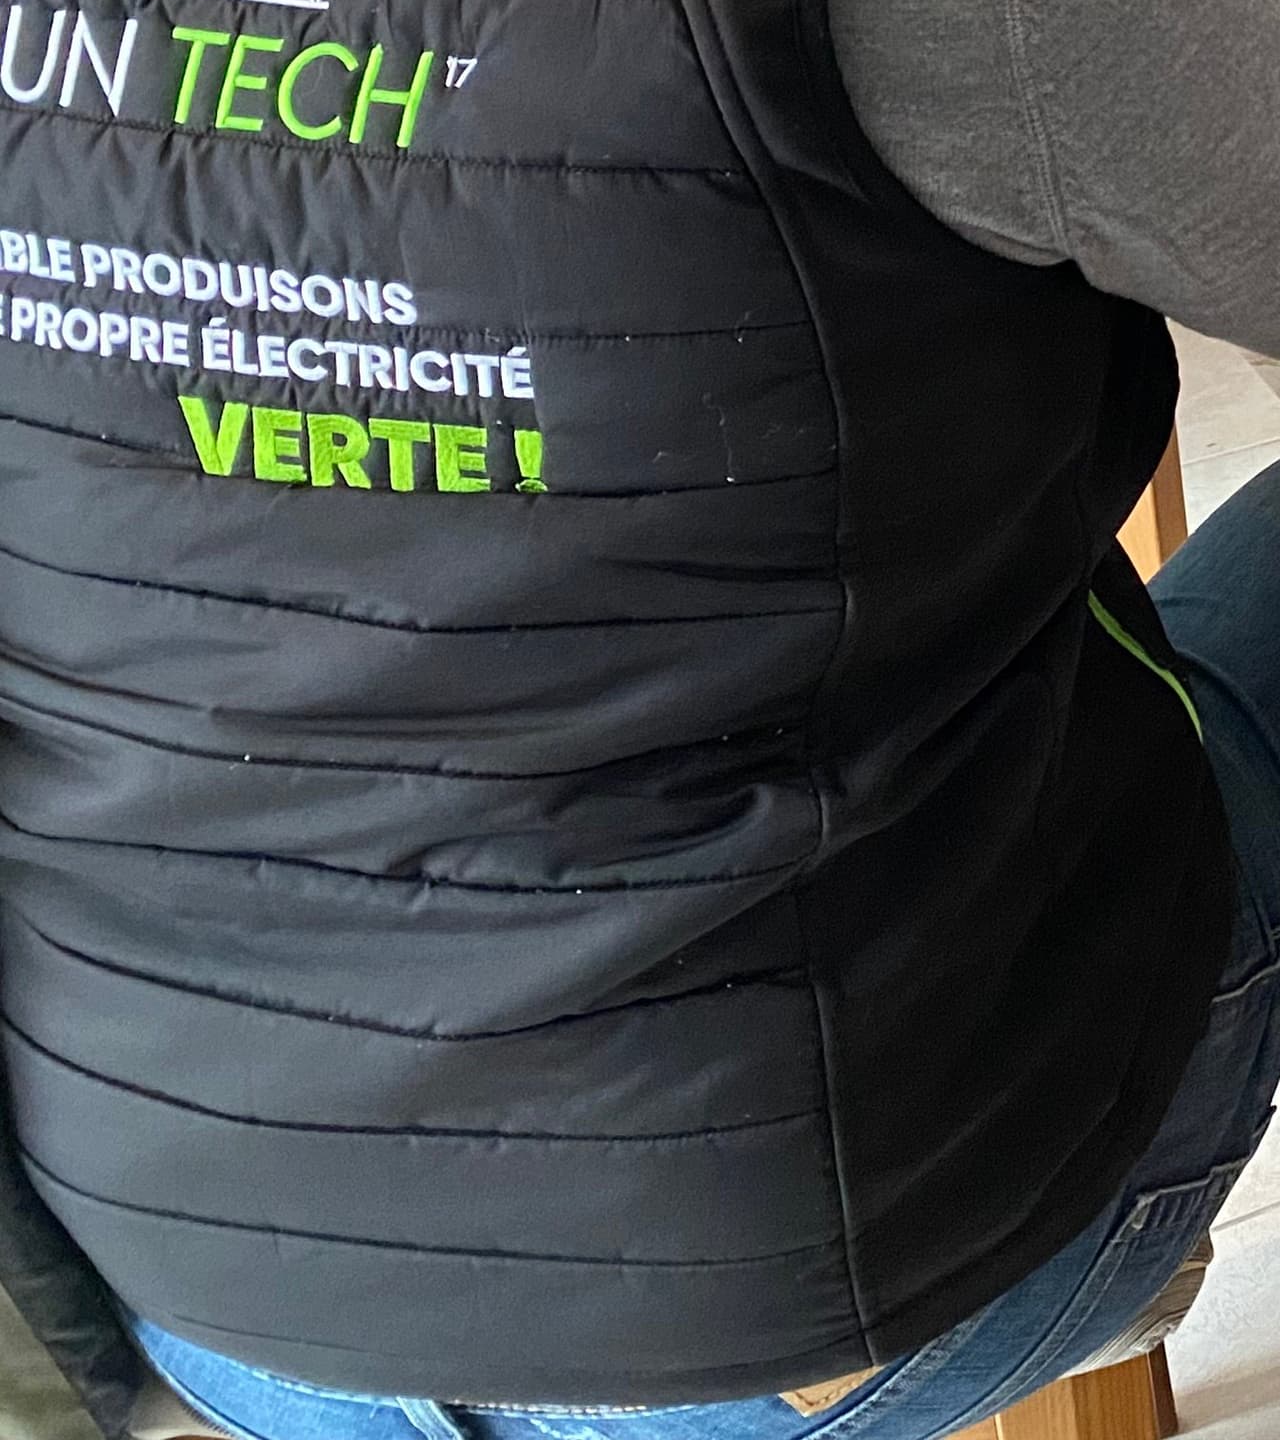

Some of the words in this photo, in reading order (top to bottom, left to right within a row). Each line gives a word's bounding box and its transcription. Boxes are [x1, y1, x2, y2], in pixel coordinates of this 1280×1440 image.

[0, 4, 139, 118] UN
[171, 26, 435, 147] TECH
[445, 55, 478, 91] 17
[0, 229, 76, 283] BLE
[81, 243, 418, 326] PRODUISONS
[10, 296, 190, 368] PROPRE
[201, 318, 536, 399] ÉLECTRICITÉ
[178, 393, 492, 493] VERTE
[514, 429, 549, 494] !
